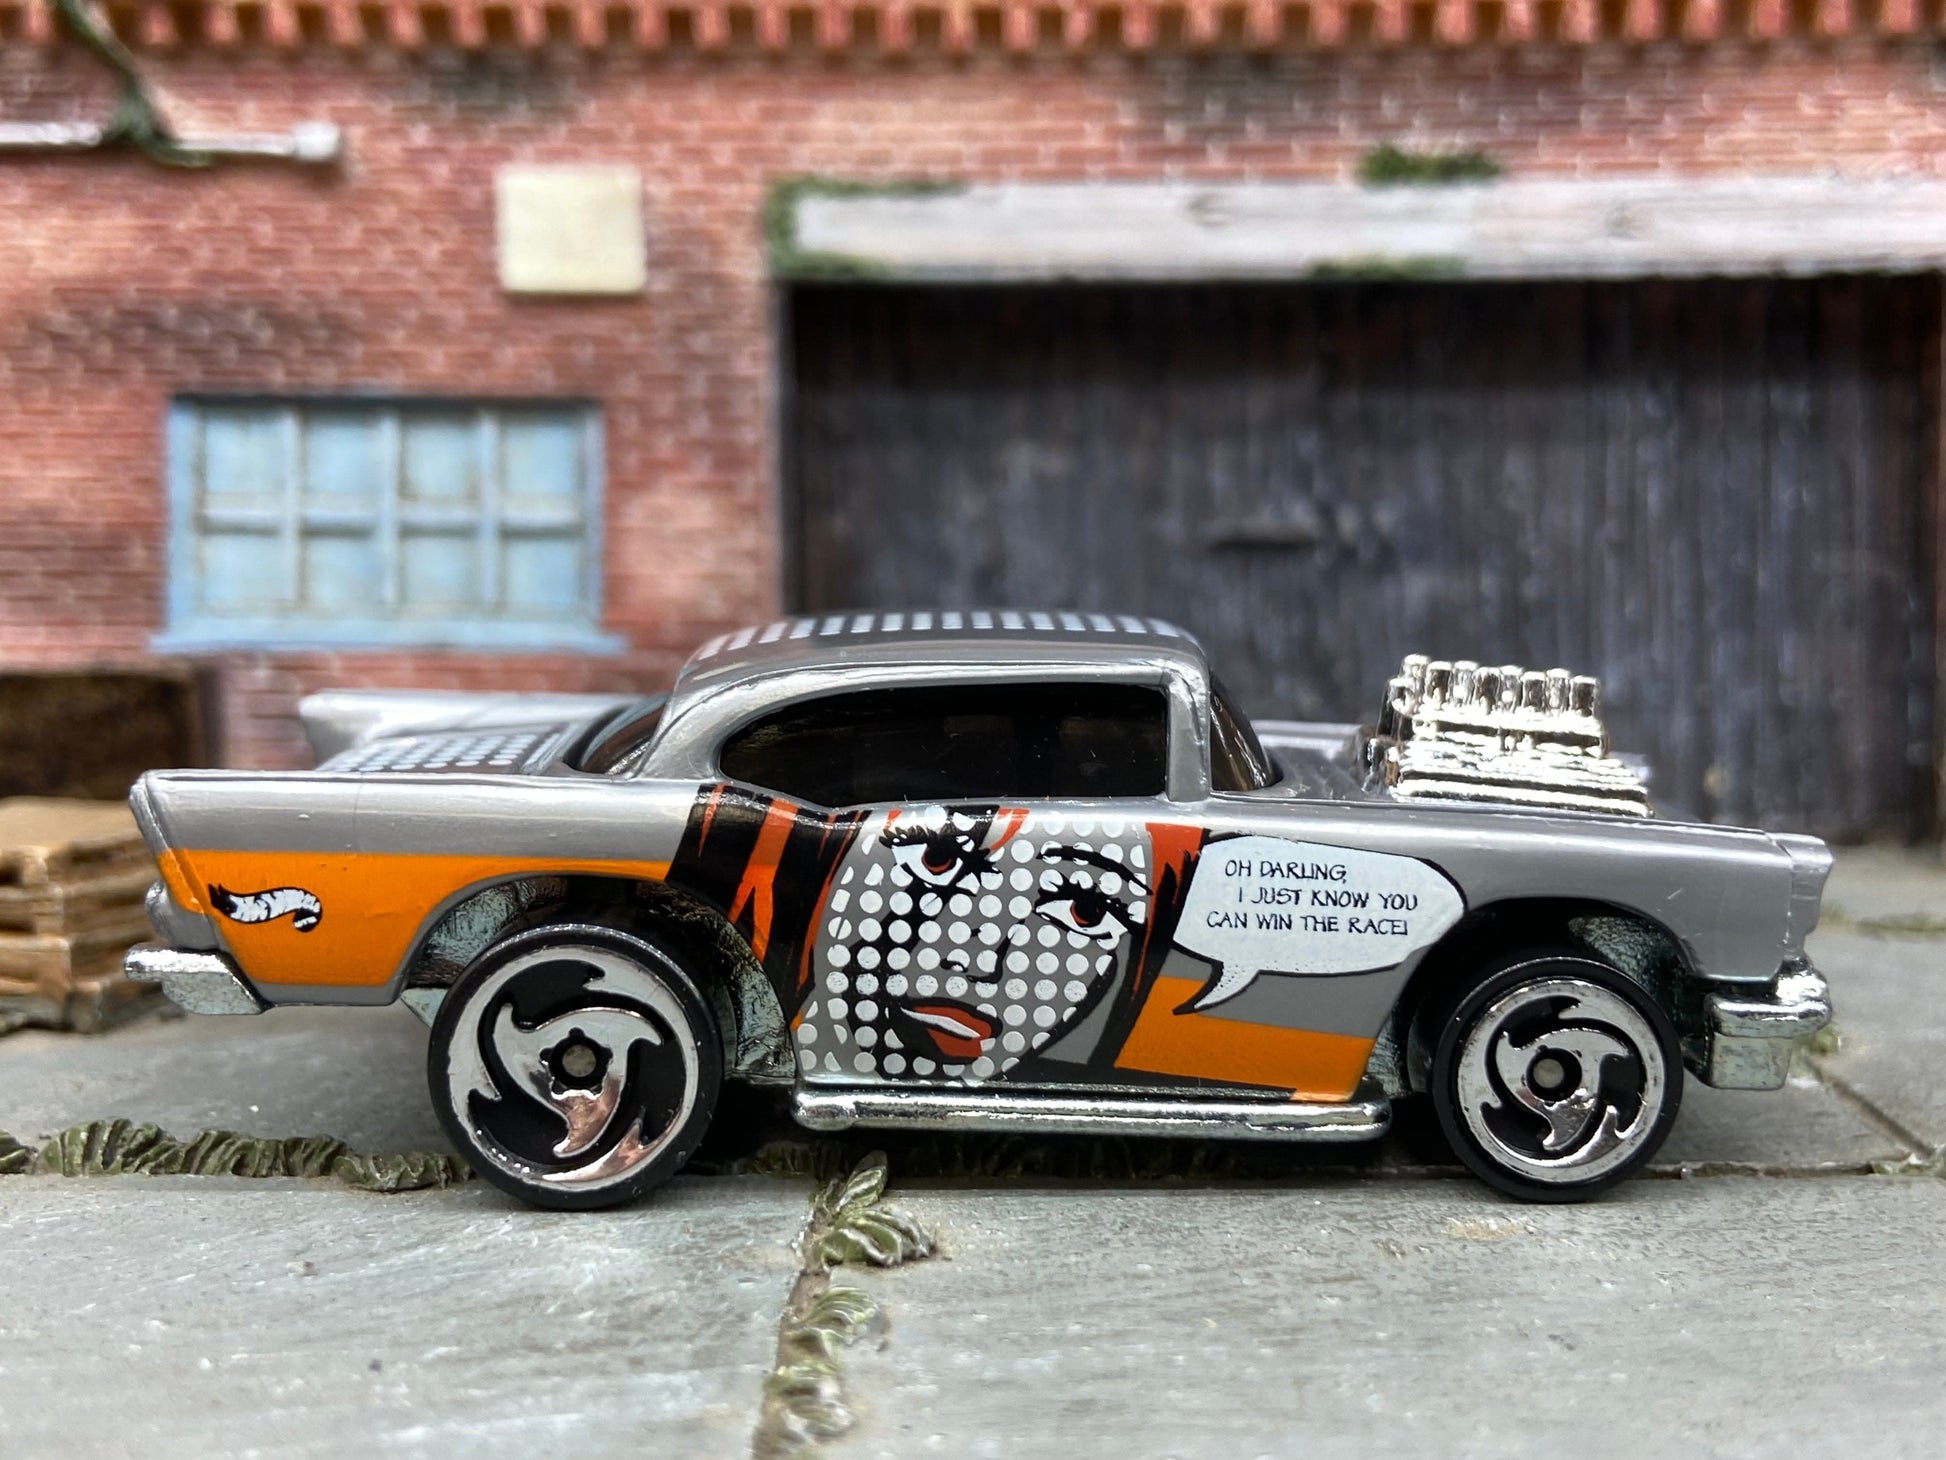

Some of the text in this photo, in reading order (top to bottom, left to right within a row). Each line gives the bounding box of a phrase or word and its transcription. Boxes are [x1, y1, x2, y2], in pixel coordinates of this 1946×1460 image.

[1225, 859, 1347, 884] OH DARLING,
[1238, 887, 1418, 911] I JUST KNOW YOU
[1206, 911, 1248, 929] CAN
[1256, 912, 1292, 931] WIN
[1300, 914, 1340, 932] THE
